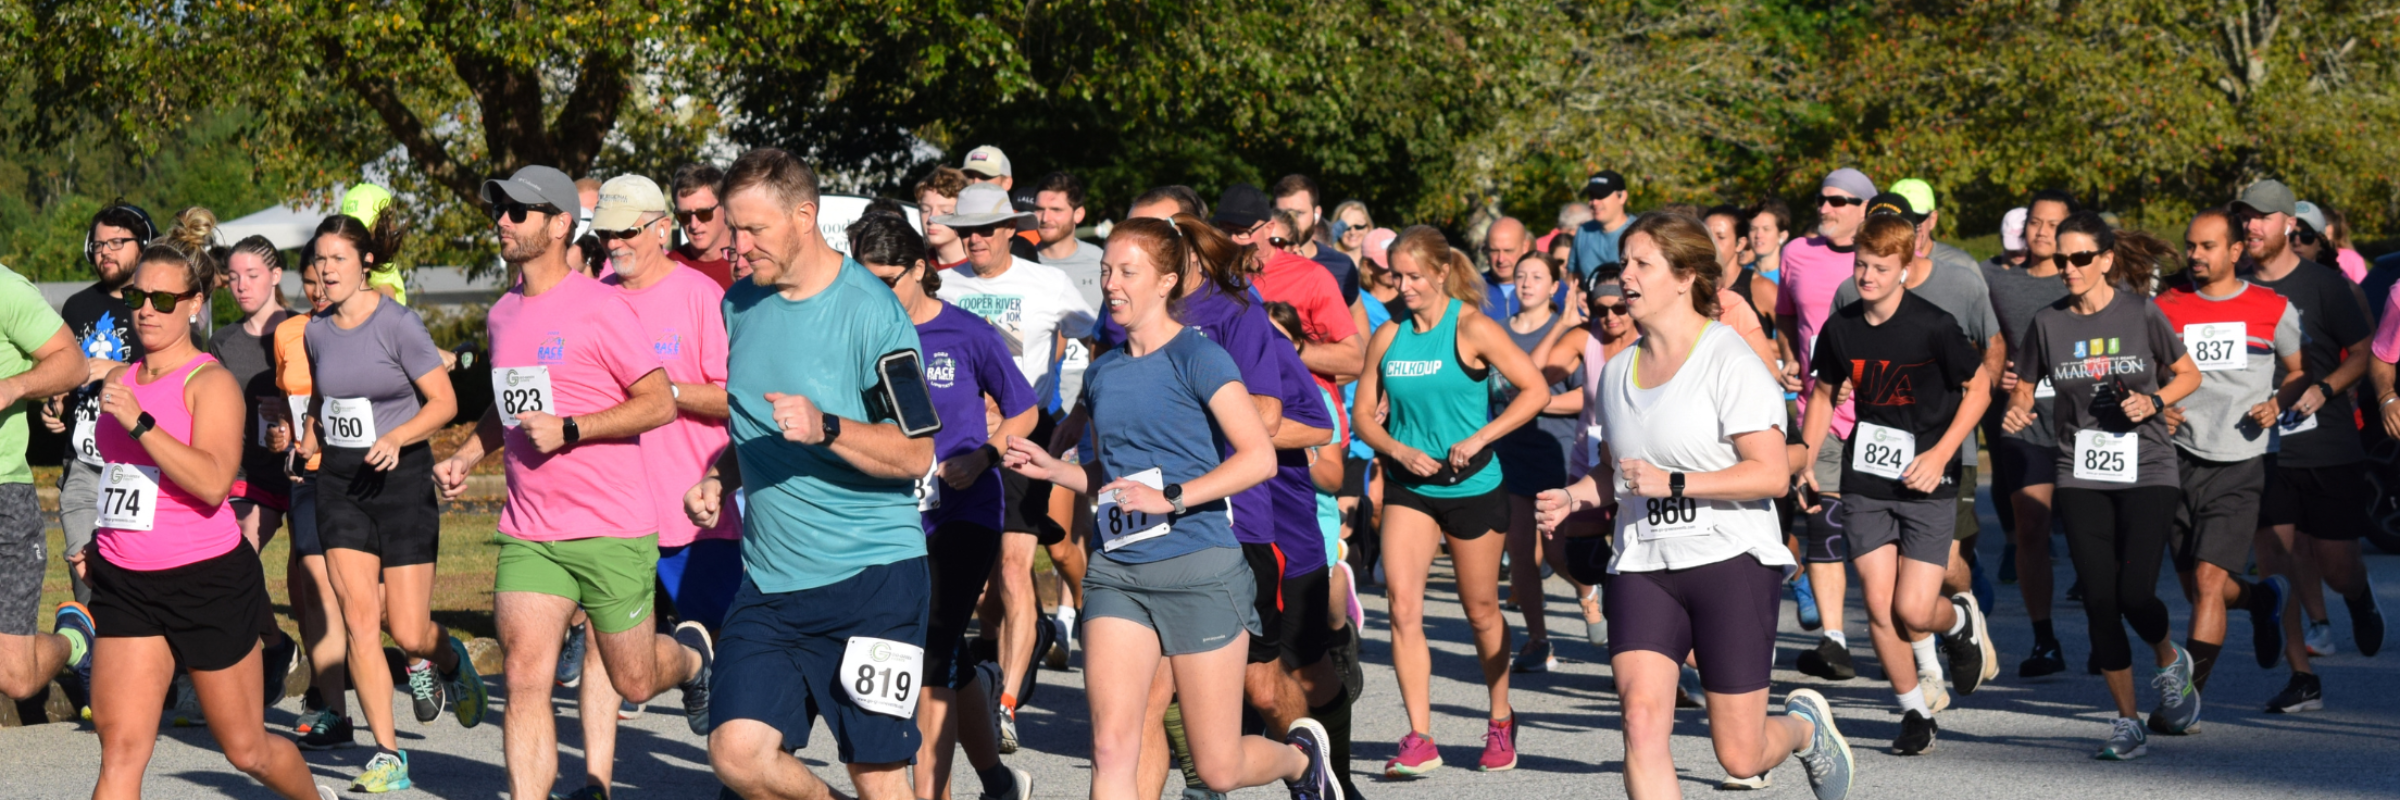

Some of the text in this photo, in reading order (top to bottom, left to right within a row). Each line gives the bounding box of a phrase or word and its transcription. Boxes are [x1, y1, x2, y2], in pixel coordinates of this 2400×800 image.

[818, 218, 851, 234] ood
[996, 297, 1022, 311] RIVER
[1007, 312, 1021, 322] 10K
[538, 346, 564, 356] RACE
[654, 342, 680, 353] RACE
[2196, 340, 2235, 362] 837
[927, 366, 955, 377] RACE
[2054, 358, 2145, 380] MARATHON
[503, 388, 543, 415] 823
[328, 415, 363, 438] 760
[1864, 442, 1902, 469] 824
[2085, 449, 2125, 472] 825
[103, 487, 141, 517] 774
[1646, 496, 1697, 526] 860
[855, 664, 912, 702] 819
